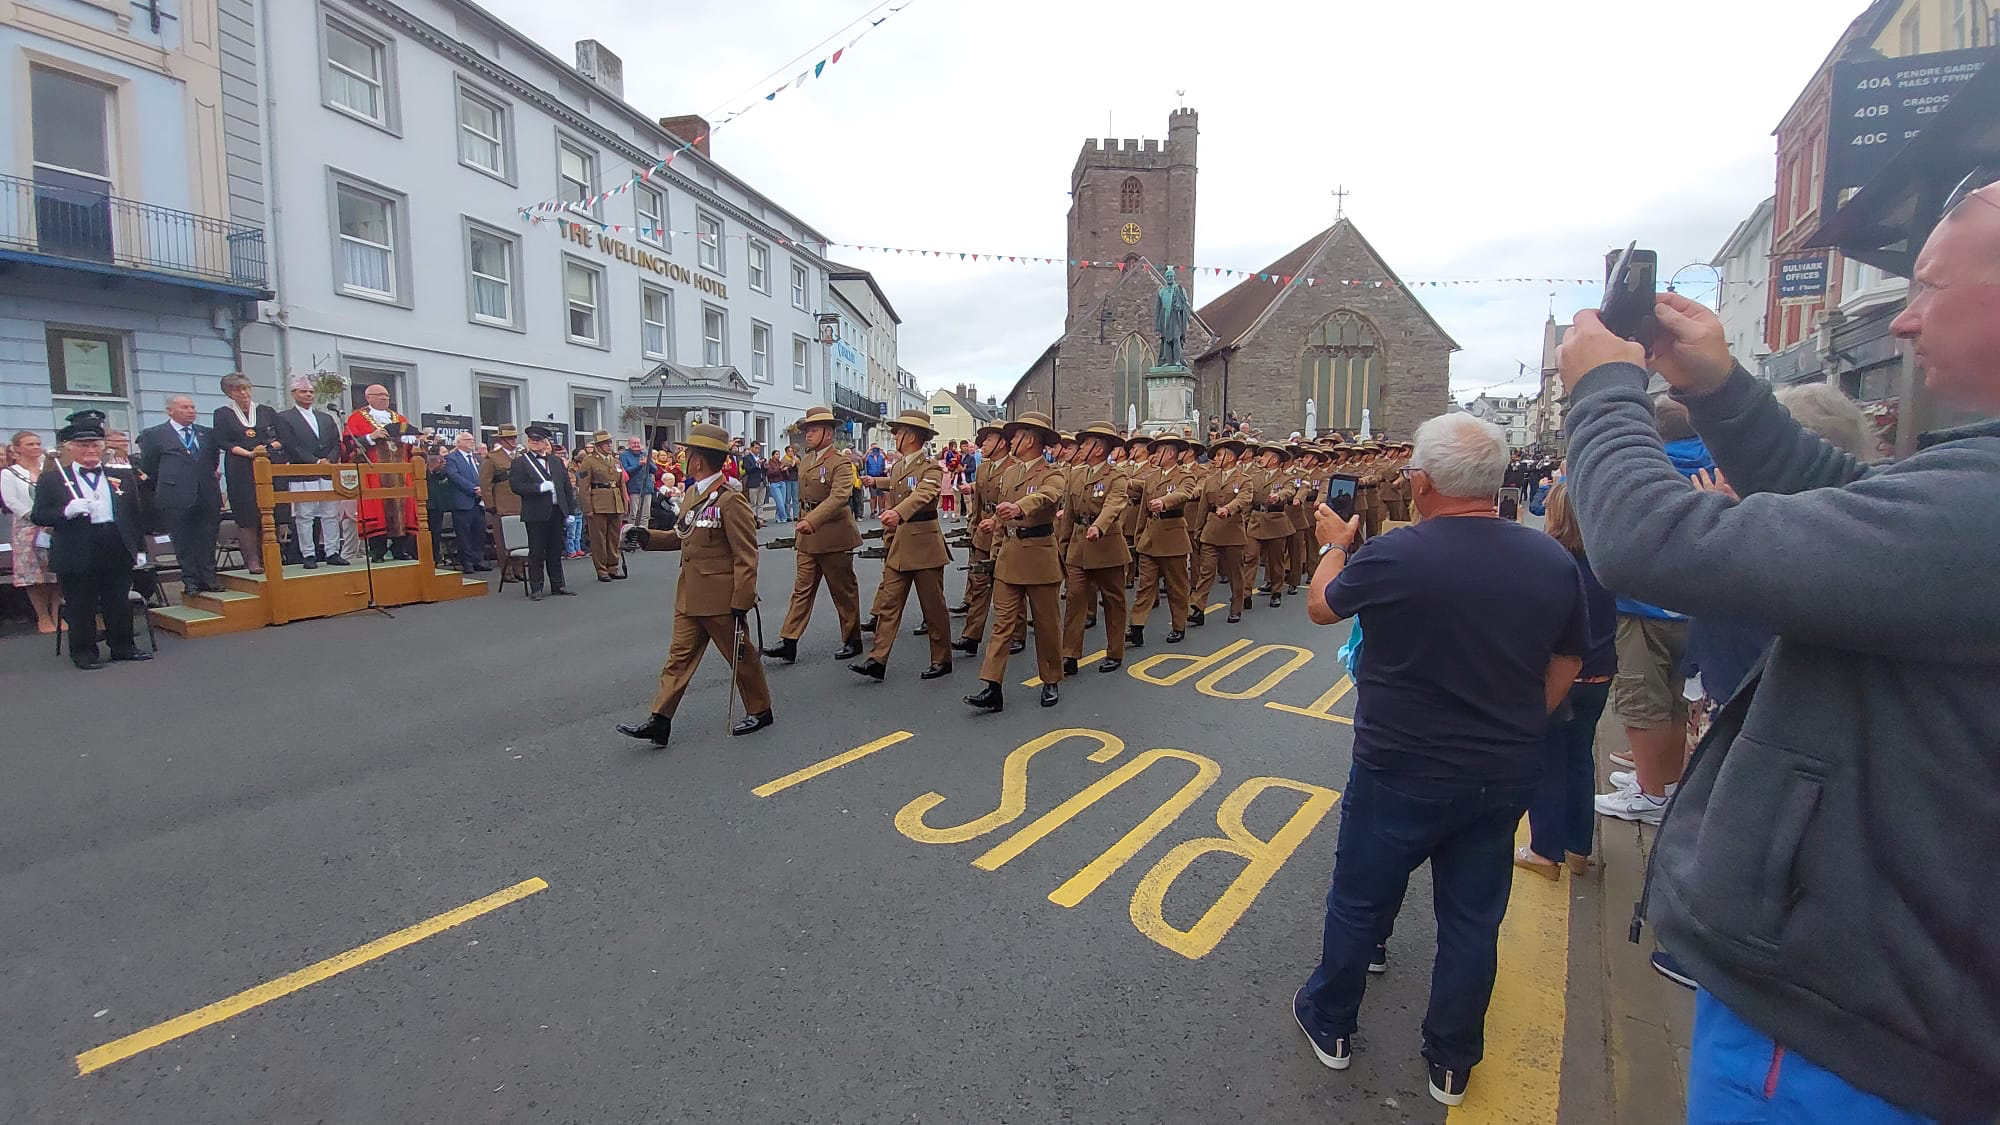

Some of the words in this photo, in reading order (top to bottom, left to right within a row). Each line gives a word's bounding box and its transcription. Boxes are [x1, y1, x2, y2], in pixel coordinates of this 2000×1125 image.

[1857, 76, 1892, 90] 40A
[1896, 67, 1942, 80] PENDRE
[1943, 62, 1985, 75] GARDE
[1898, 77, 1931, 88] MAES
[1933, 76, 1940, 84] Y
[1854, 104, 1889, 118] 40B
[1902, 94, 1950, 107] CRADOC
[1851, 132, 1888, 146] 40C
[558, 217, 593, 248] THE
[597, 233, 691, 285] WELLINGTON
[694, 272, 729, 300] HOTEL
[1782, 262, 1823, 273] BULWARK
[1785, 271, 1820, 281] OFFICES
[1127, 638, 1355, 725] TOP
[895, 728, 1341, 960] BUS
